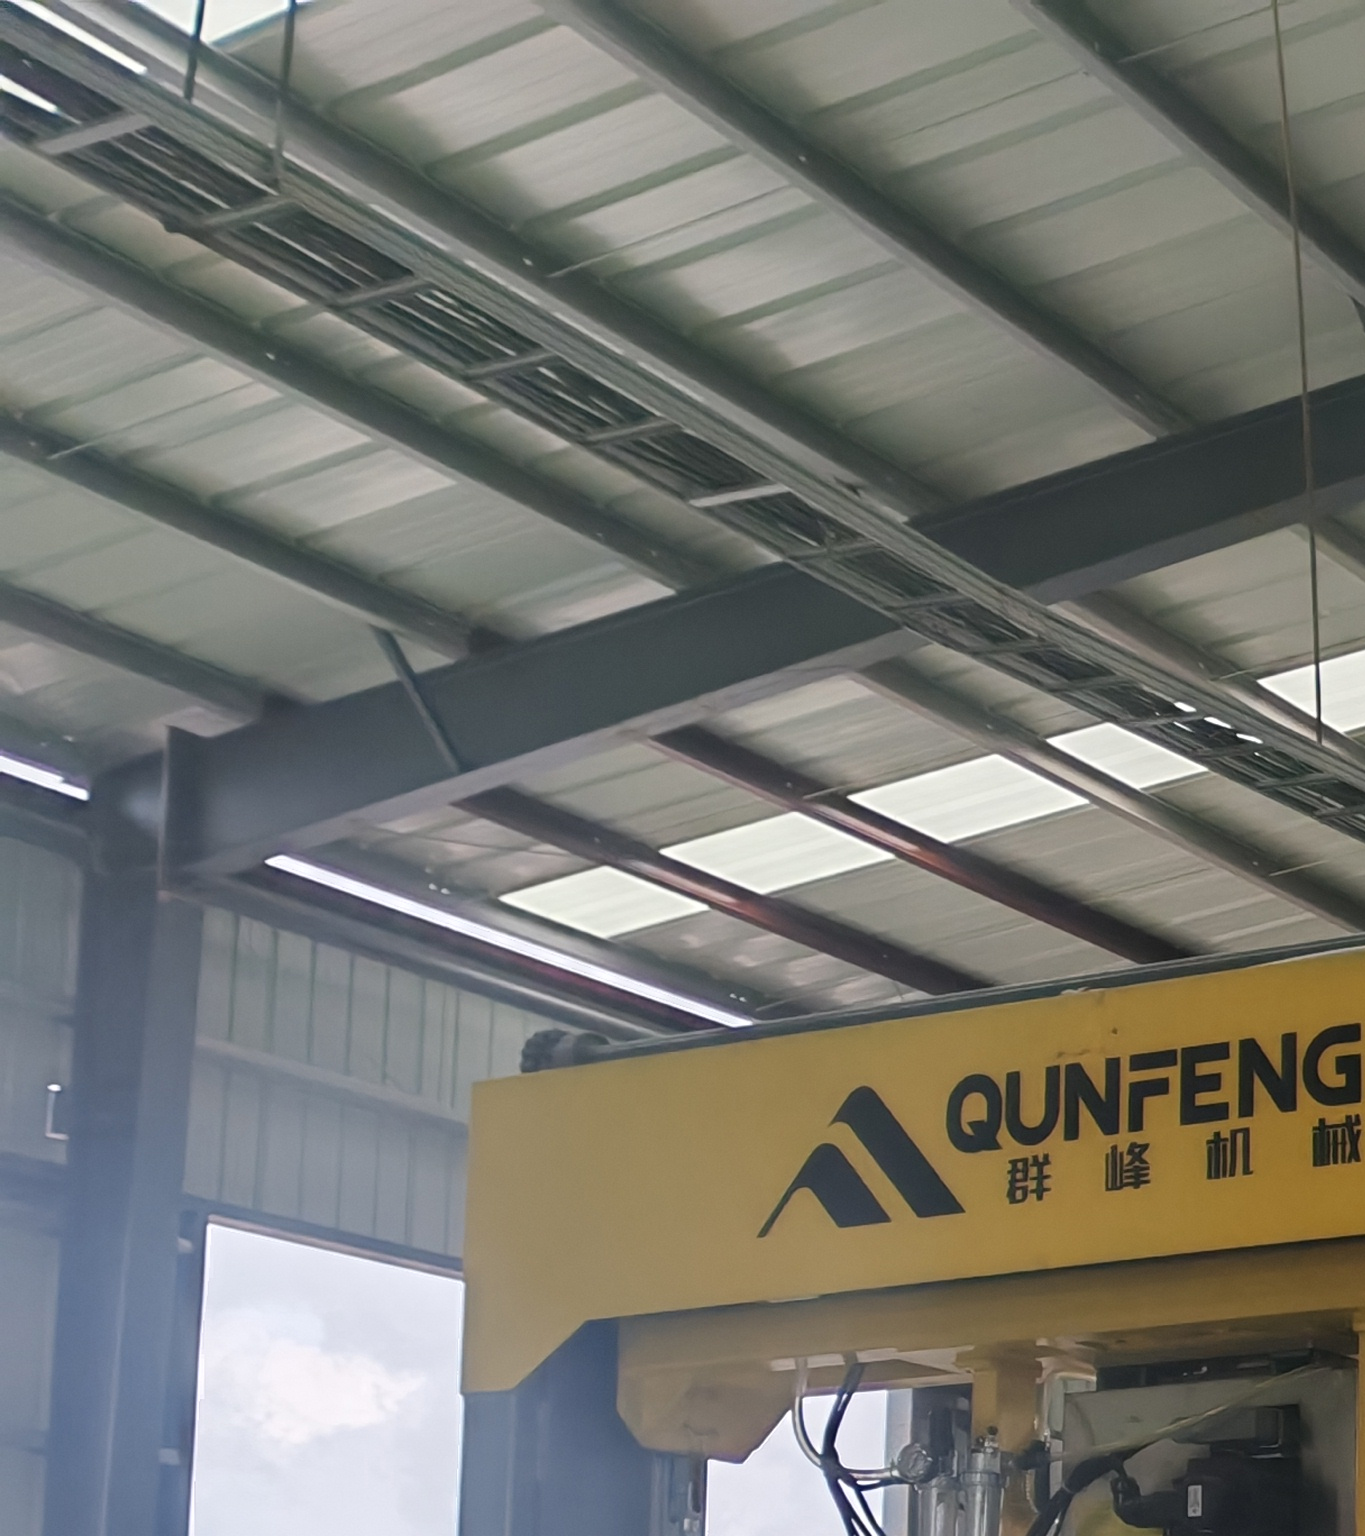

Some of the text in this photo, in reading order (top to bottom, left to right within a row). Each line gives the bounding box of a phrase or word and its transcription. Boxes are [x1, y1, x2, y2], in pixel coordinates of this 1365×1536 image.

[945, 1022, 1363, 1154] QUNFENG
[1006, 1112, 1362, 1205] 群峰机械
